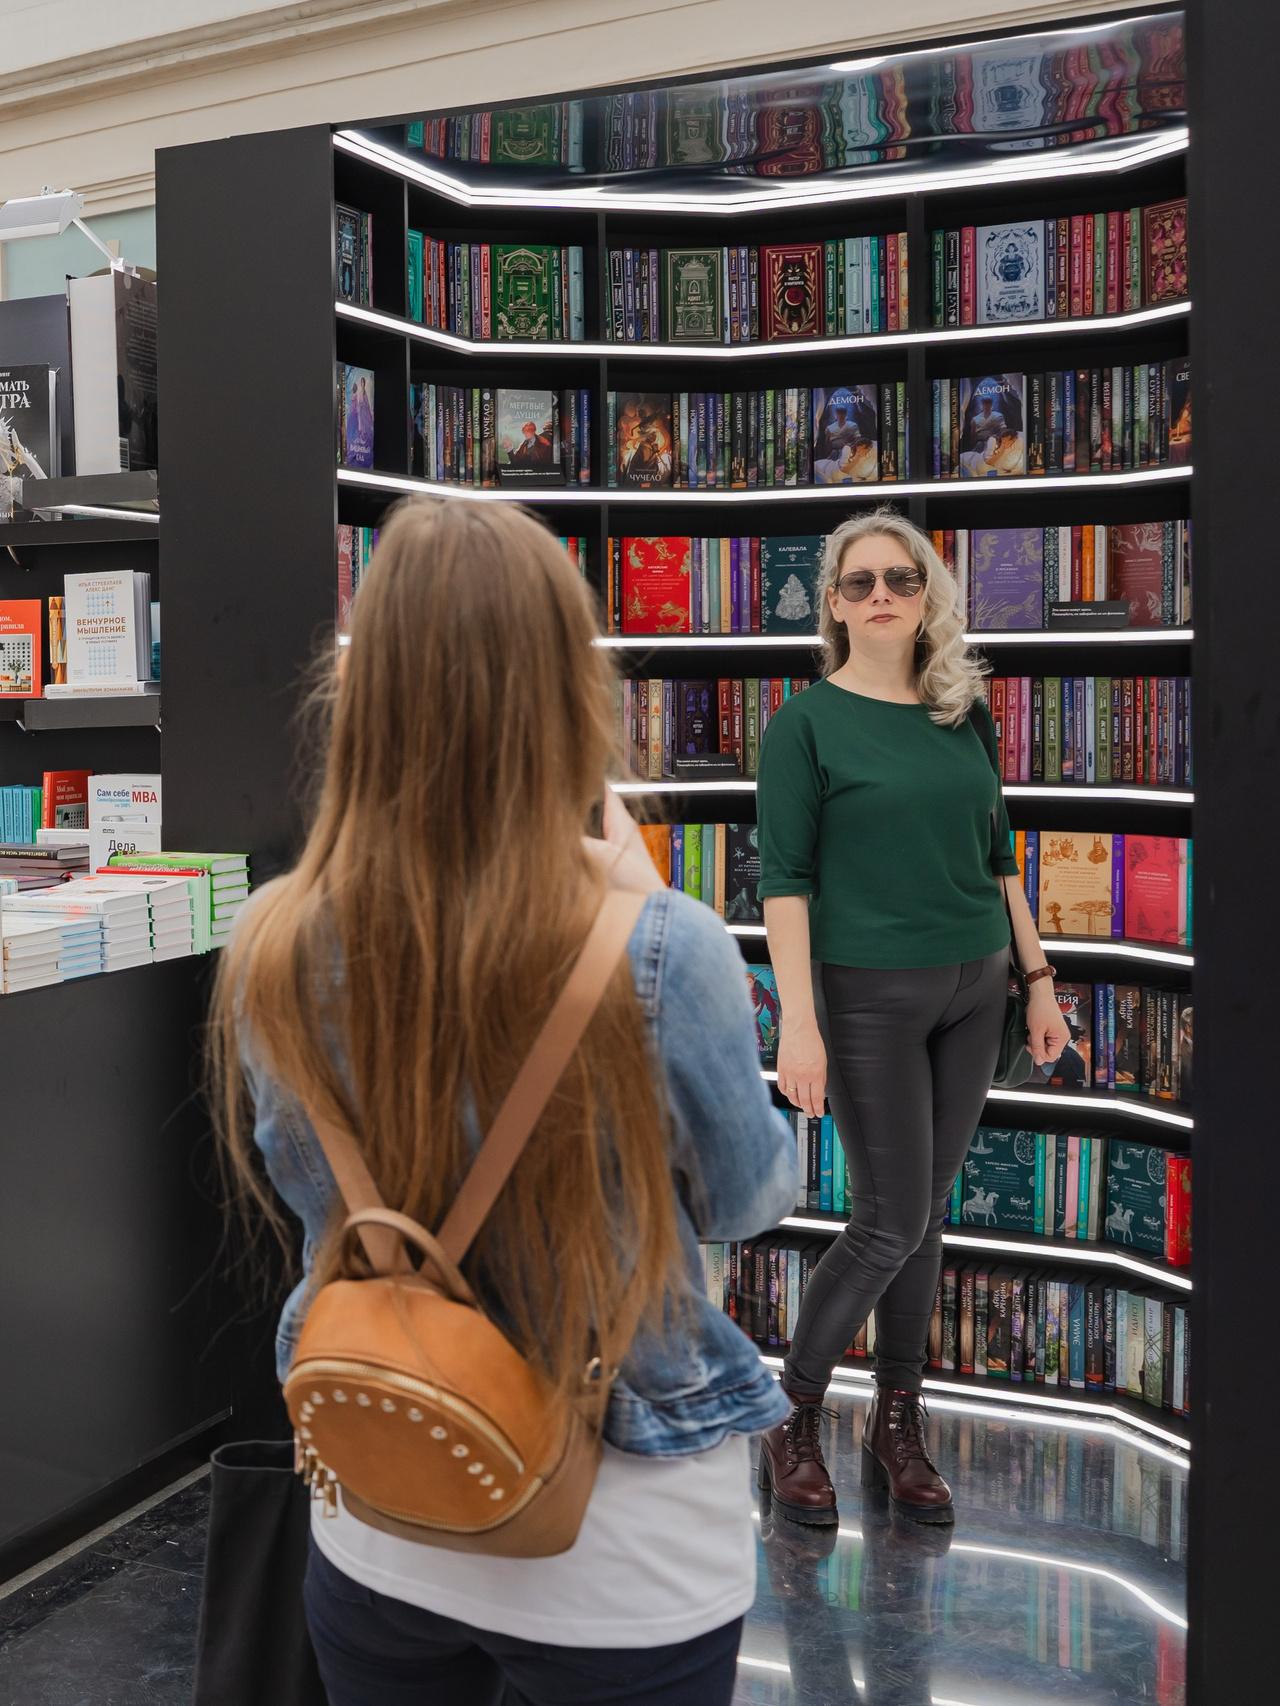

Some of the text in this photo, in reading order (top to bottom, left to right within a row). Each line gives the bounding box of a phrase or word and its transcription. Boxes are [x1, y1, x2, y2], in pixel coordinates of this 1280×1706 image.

[974, 384, 1010, 396] ДЕМОН
[828, 395, 864, 406] ДЕМОН
[509, 401, 545, 410] МЕРТВЫЕ
[514, 410, 540, 419] ДУШИ
[629, 473, 662, 482] ЧУЧЕЛО
[76, 616, 126, 626] ВЕНЧУРНОЕ
[77, 625, 126, 634] МЫШЛЕНИЕ
[96, 788, 130, 797] Сам себе
[132, 791, 158, 803] MBA
[108, 839, 136, 852] Дела
